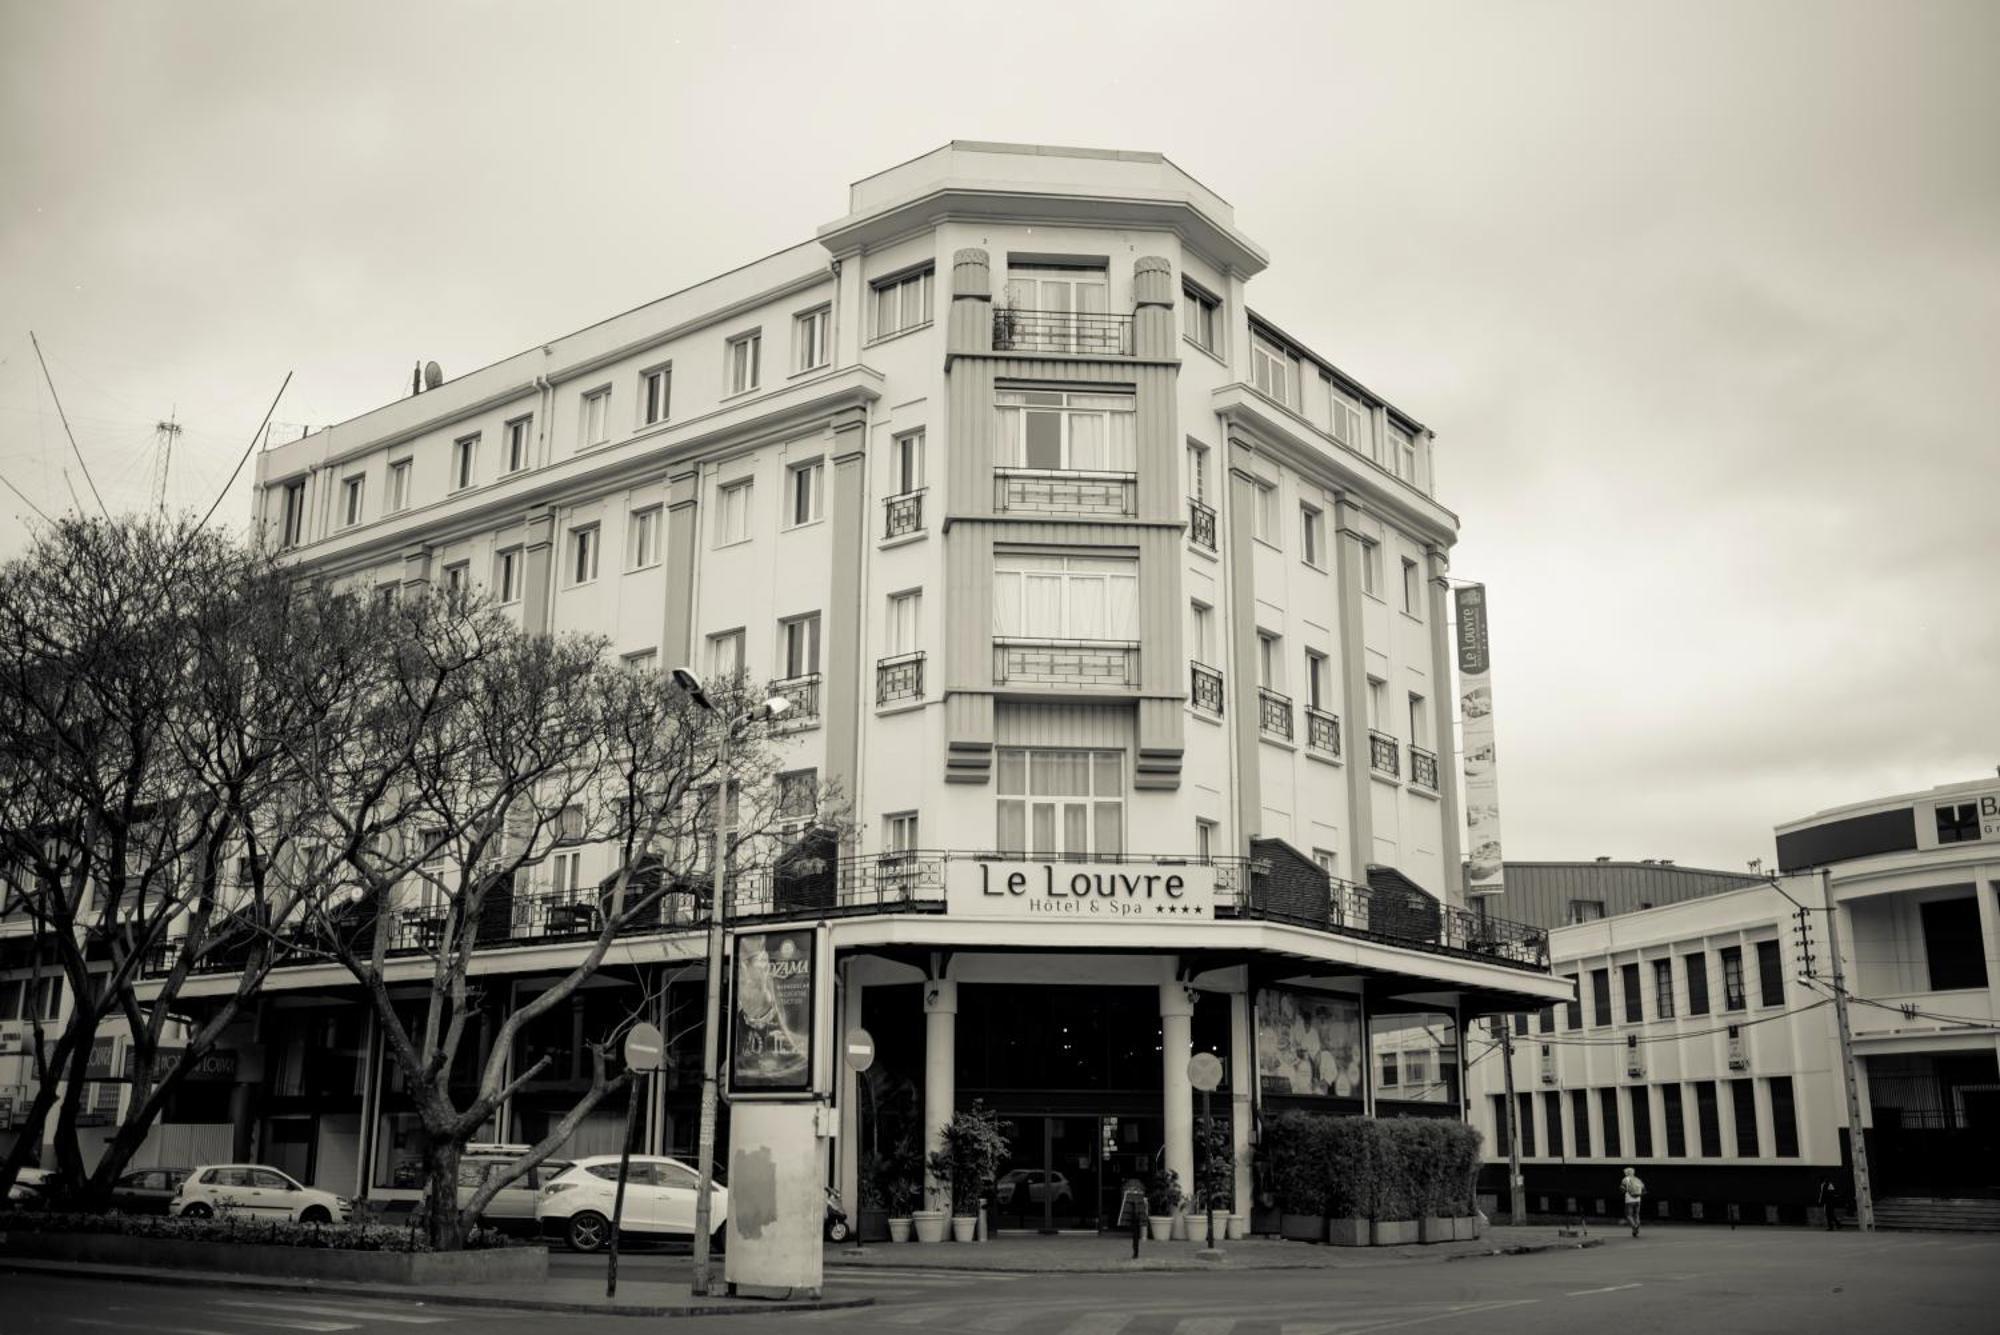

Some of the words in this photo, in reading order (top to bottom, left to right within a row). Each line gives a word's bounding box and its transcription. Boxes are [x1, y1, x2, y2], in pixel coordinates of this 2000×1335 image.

[1462, 608, 1476, 650] Louvre
[1462, 652, 1477, 668] Le
[1981, 797, 2000, 816] B
[979, 864, 1026, 897] Le
[1044, 865, 1184, 898] Louvre
[1090, 900, 1100, 912] &
[1110, 900, 1142, 916] Spa
